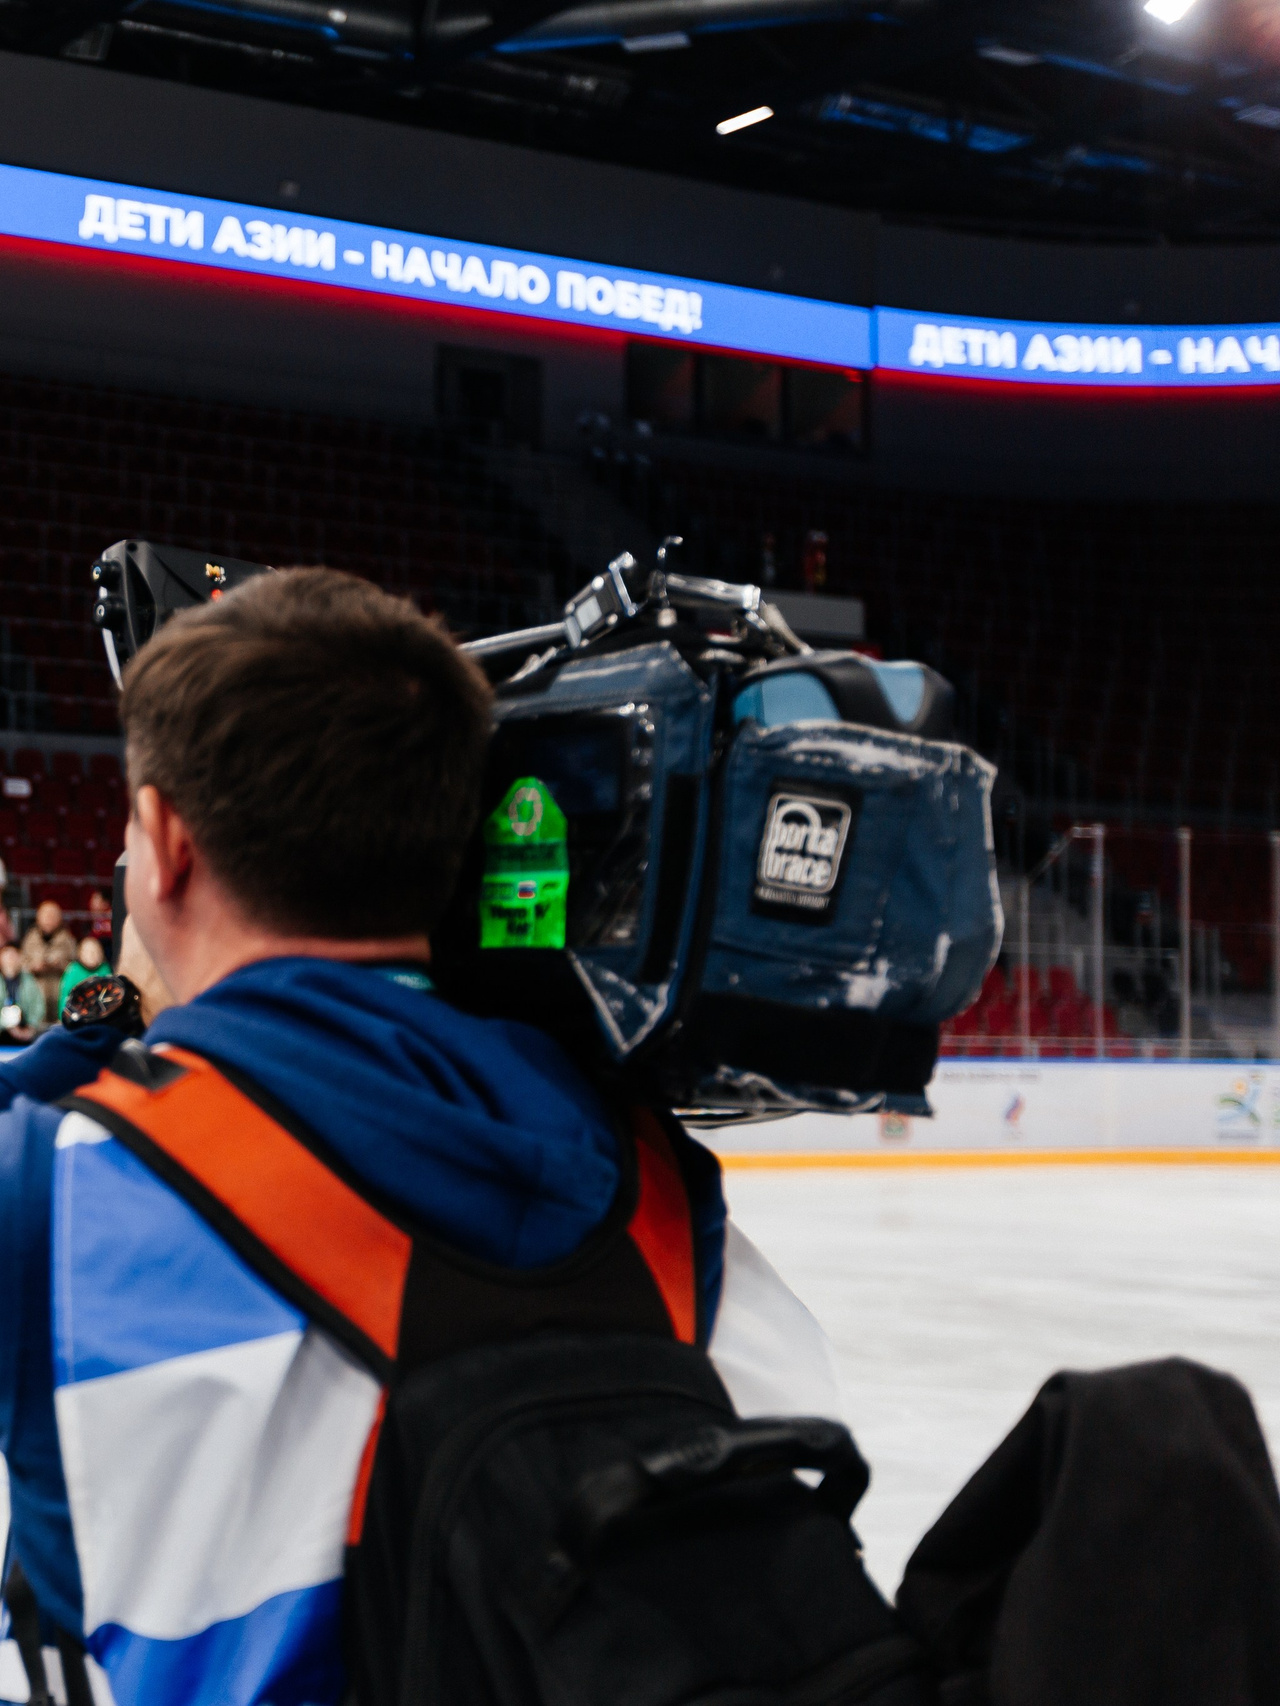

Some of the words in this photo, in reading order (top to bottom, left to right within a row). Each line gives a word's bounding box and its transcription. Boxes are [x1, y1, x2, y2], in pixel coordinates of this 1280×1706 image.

[78, 194, 205, 250] ДЕТИ
[211, 216, 336, 271] АЗИИ
[343, 249, 365, 265] -
[370, 240, 551, 304] НАЧАЛО
[556, 270, 704, 334] ПОБЕД!
[908, 323, 1017, 368] ДЕТИ
[1022, 333, 1142, 374] АЗИИ
[1148, 349, 1172, 365] -
